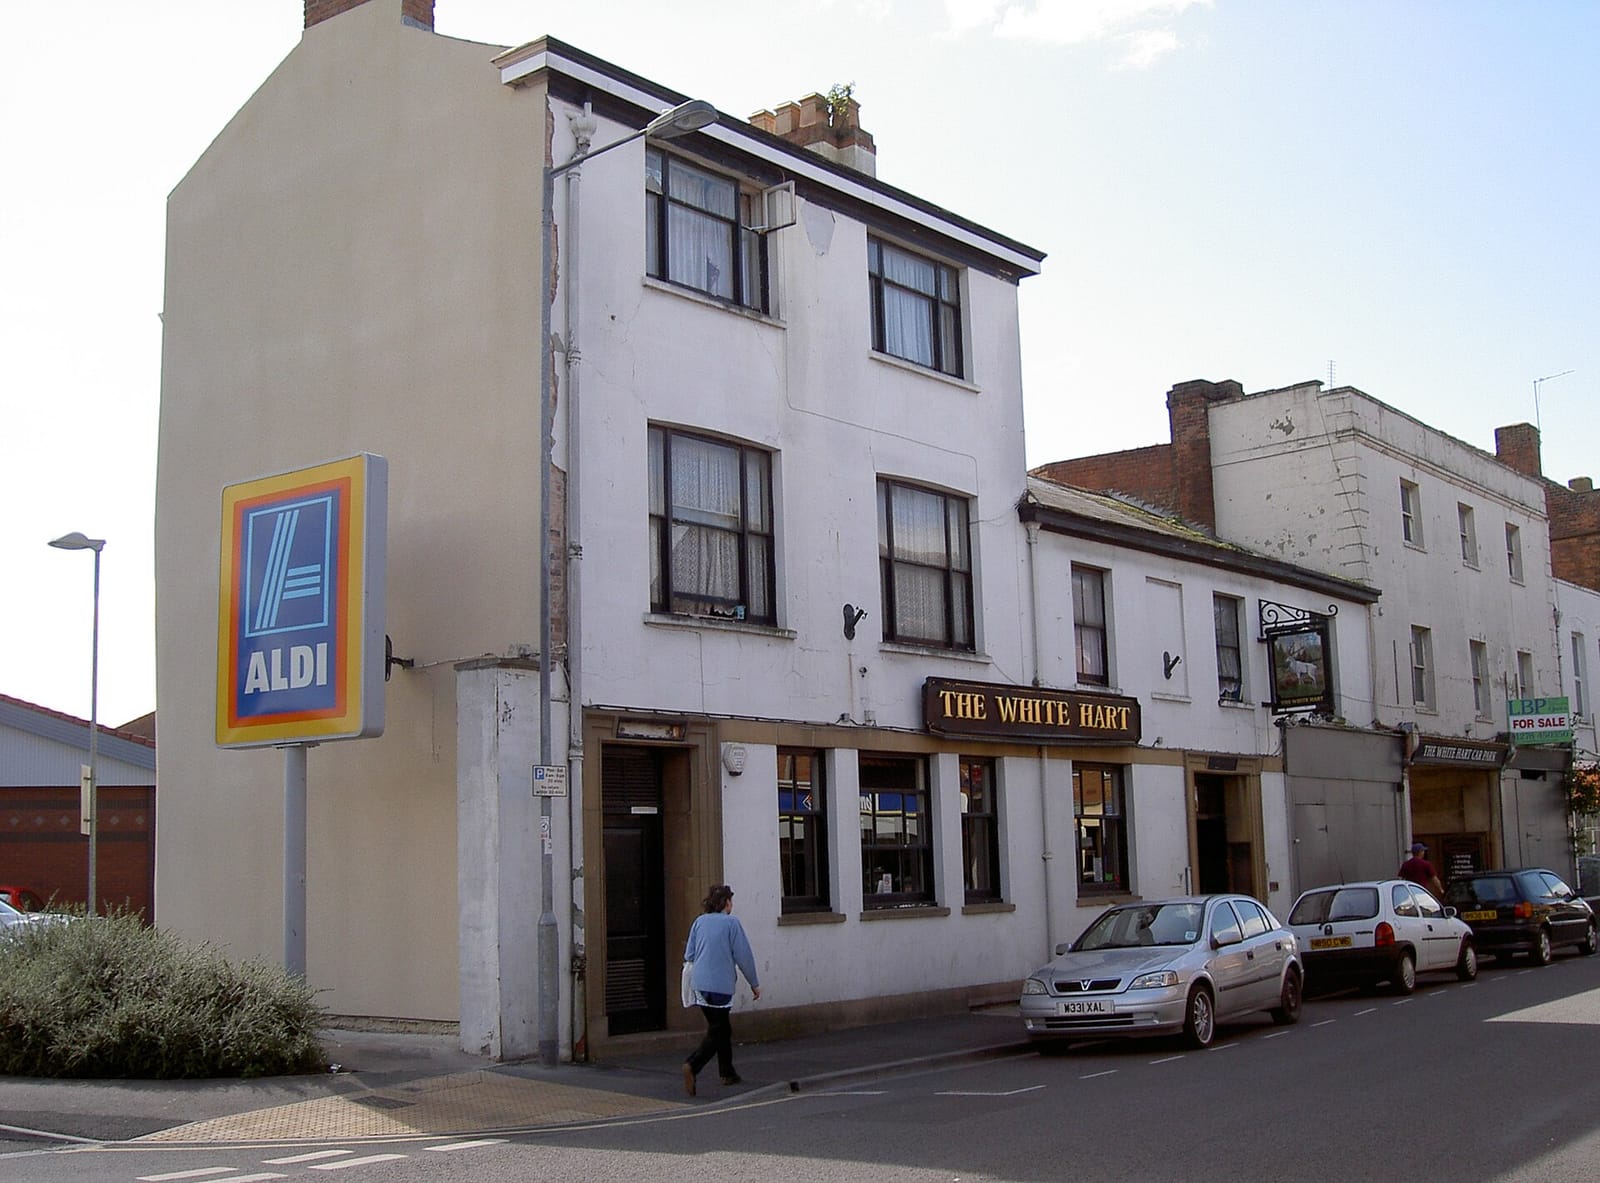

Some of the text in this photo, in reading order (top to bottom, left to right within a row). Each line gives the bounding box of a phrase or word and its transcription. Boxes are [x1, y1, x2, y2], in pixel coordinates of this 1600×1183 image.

[244, 642, 328, 694] ALDI
[939, 690, 1131, 731] THE WHITE HART
[1507, 698, 1547, 716] LBP
[1513, 717, 1566, 729] FOR SALE
[1423, 745, 1436, 757] THE
[1436, 746, 1457, 759] WHITE
[1456, 747, 1473, 760] HART
[1087, 1002, 1105, 1012] XAL
